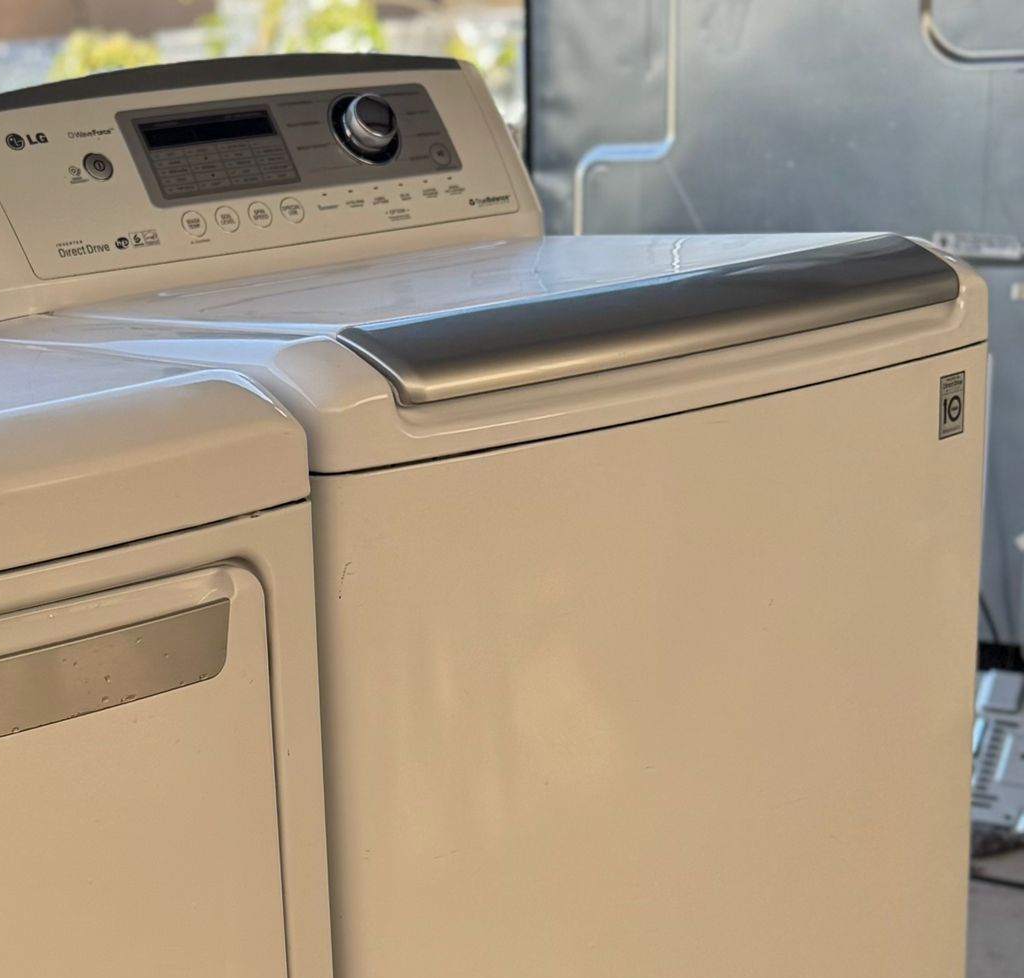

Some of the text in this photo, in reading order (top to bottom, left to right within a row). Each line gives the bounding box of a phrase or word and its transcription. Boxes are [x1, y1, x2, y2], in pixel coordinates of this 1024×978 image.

[26, 132, 49, 145] LG
[58, 243, 111, 258] Direct Drive
